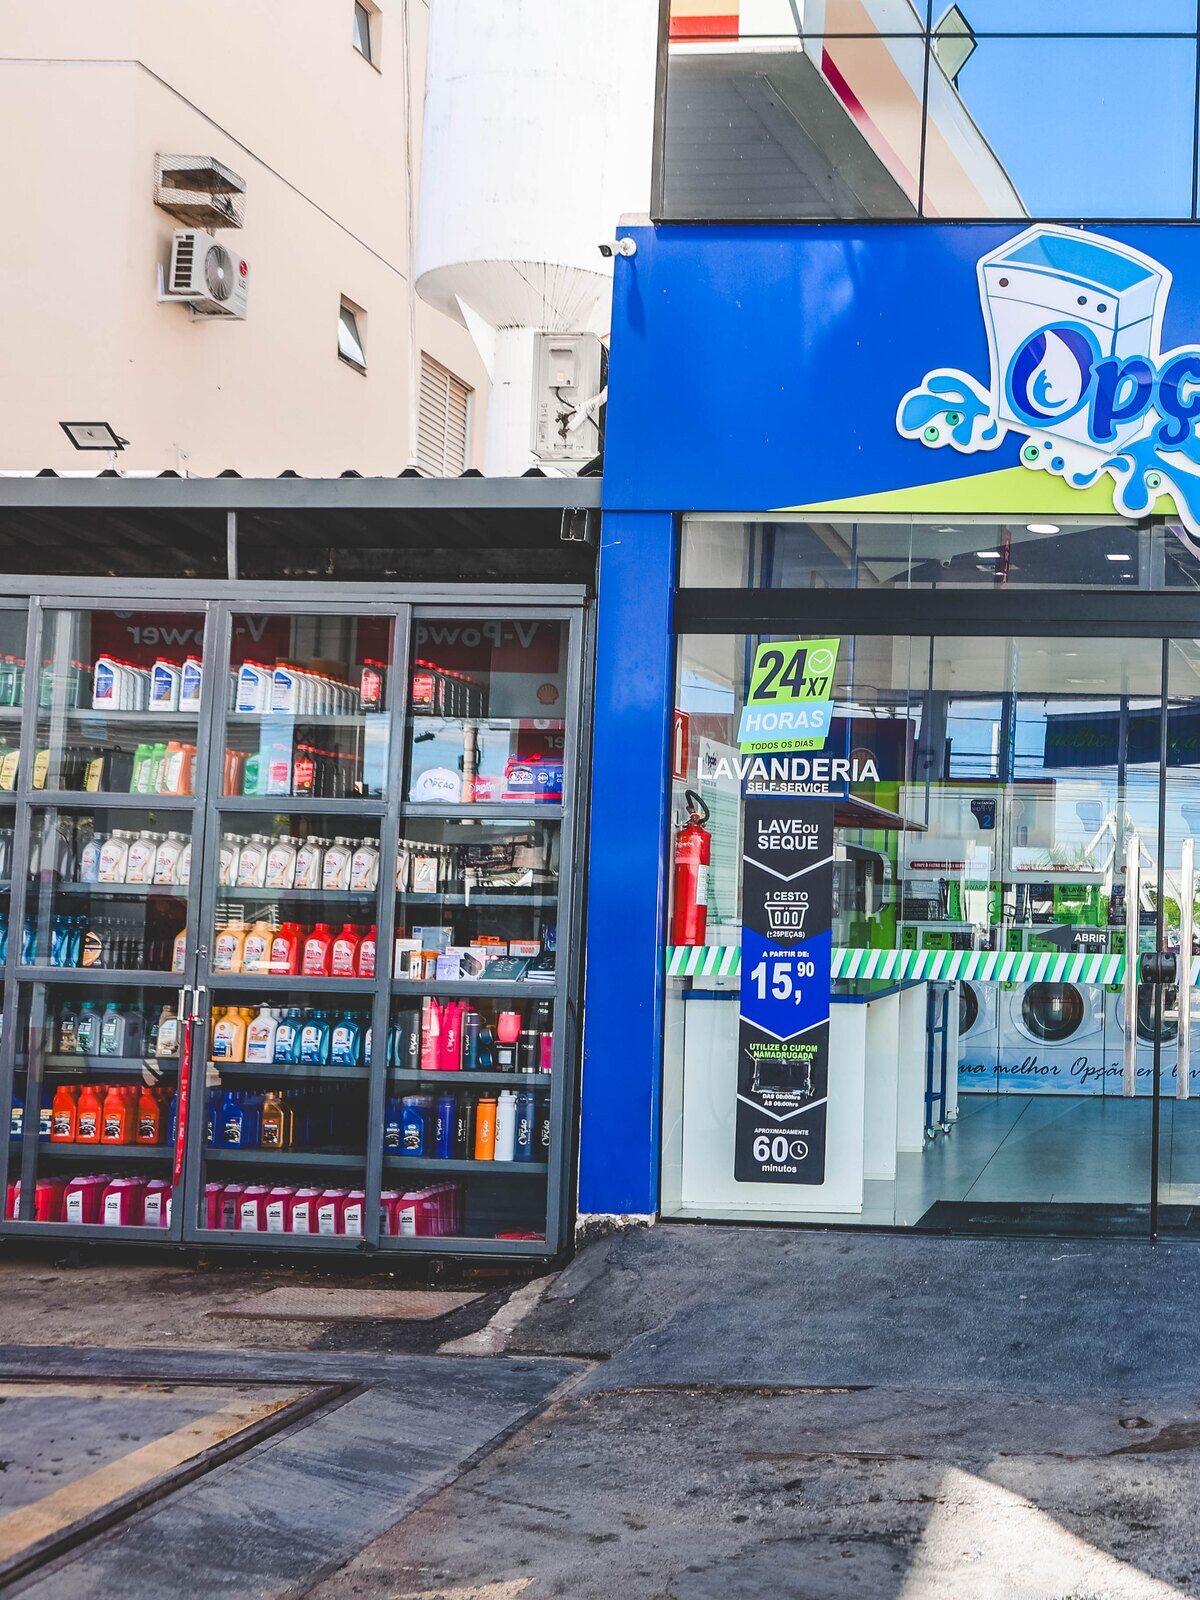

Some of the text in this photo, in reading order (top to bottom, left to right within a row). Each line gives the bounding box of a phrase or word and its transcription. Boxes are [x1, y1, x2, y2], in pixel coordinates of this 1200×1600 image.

[745, 710, 824, 732] HORAS
[750, 739, 814, 750] TODOS OS DIAS
[697, 757, 880, 782] LAVANDERIA
[747, 783, 829, 793] SELF-SERVICE
[757, 819, 802, 834] LAVE
[983, 815, 991, 827] 2
[757, 835, 818, 850] SEQUE
[765, 891, 808, 902] 1 CESTO
[1074, 933, 1106, 943] ABRIR
[749, 1043, 780, 1051] UTILIZE
[790, 1044, 818, 1052] CUPOM
[957, 1063, 986, 1075] ua
[992, 1056, 1061, 1076] melhor
[754, 1127, 809, 1136] APROXIMADAMENTE
[753, 1135, 789, 1163] 60
[762, 1163, 797, 1173] minutos
